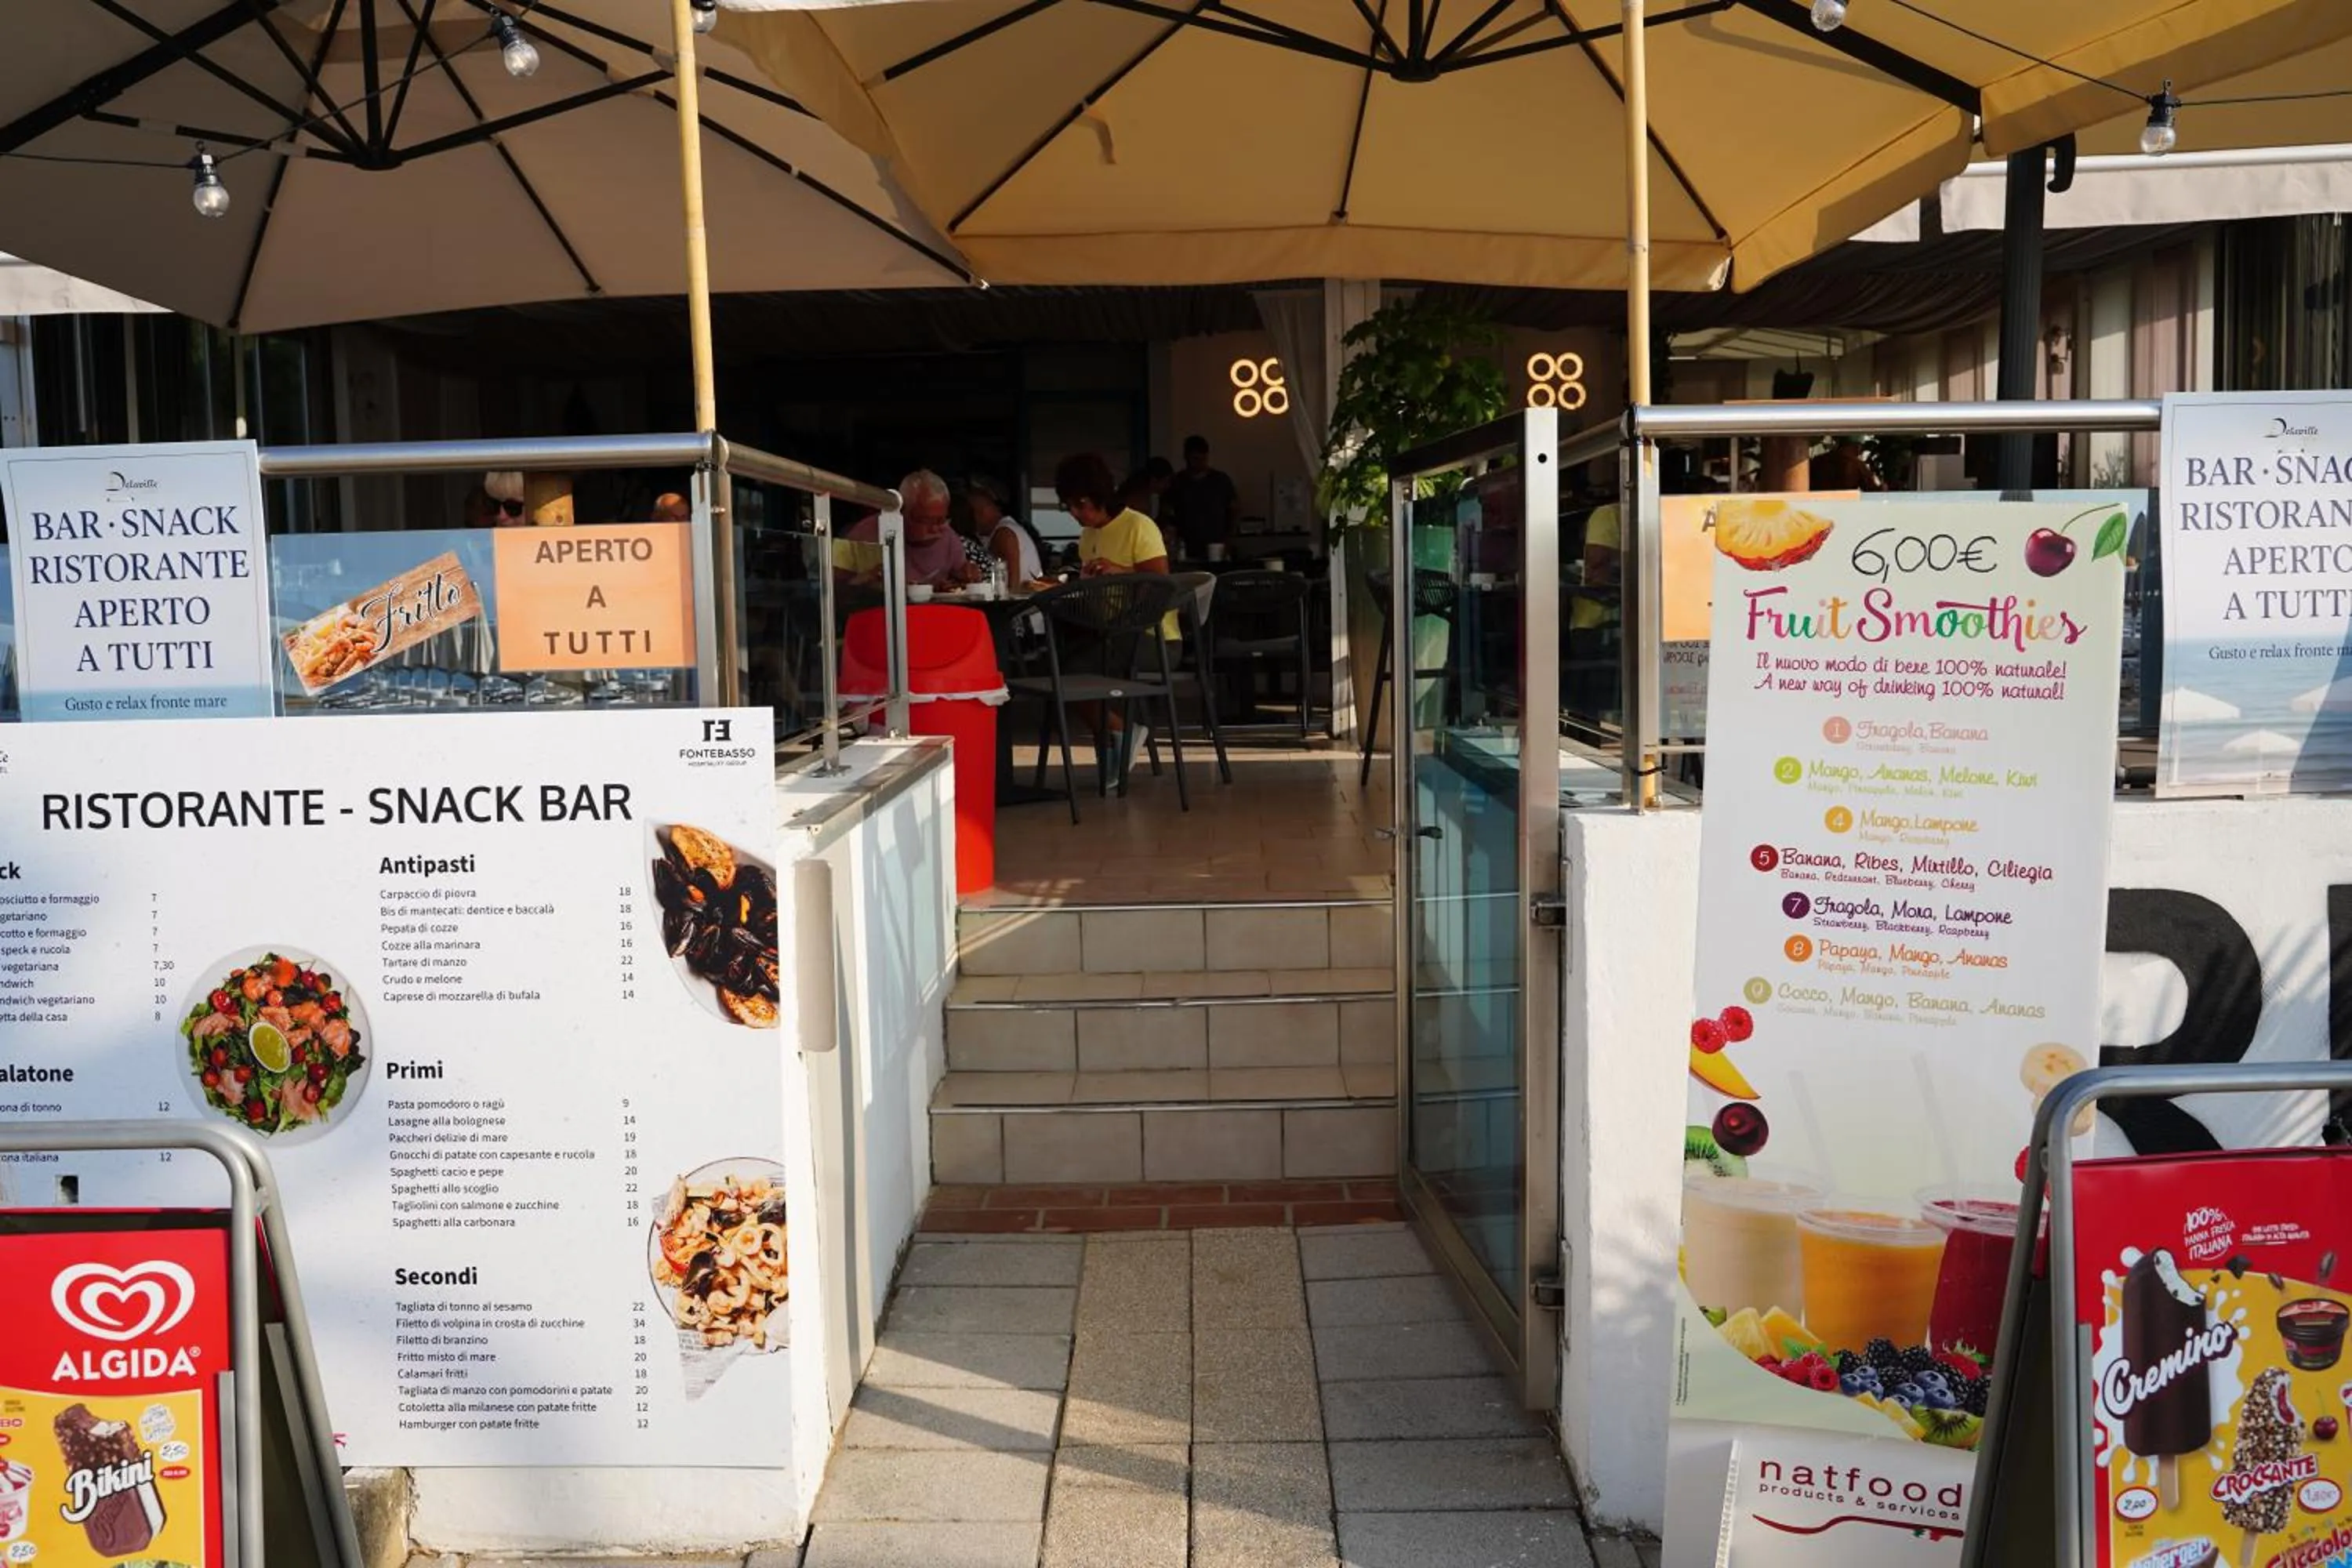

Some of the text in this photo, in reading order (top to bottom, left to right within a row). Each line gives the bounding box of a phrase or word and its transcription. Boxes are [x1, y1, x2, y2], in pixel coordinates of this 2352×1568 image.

[535, 538, 653, 564] APERTO
[1852, 528, 1998, 583] 6,00€
[30, 550, 250, 585] RISTORANTE
[586, 584, 606, 608] A
[2223, 590, 2352, 619] A TUTT
[74, 595, 211, 628] APERTO
[361, 571, 463, 653] Fritto
[1744, 586, 2087, 652] Fruit Smoothies
[544, 629, 652, 655] TUTTI
[2209, 645, 2246, 659] Gusto
[2250, 649, 2257, 659] e
[2260, 644, 2291, 659] relax
[2295, 644, 2332, 658] fronte
[77, 640, 214, 672] A TUTTI
[1756, 652, 2067, 678] Il nuovo modo di bere 100% naturale!
[1754, 673, 2064, 700] A new way of drinking 100% natural!
[65, 693, 227, 712] Gusto e relax fronte mare
[679, 748, 756, 759] FONTEBASSO
[43, 789, 325, 829] RISTORANTE
[368, 785, 524, 825] SNACK
[540, 783, 632, 821] BAR
[379, 855, 474, 877] Antipasti
[1781, 848, 1845, 869] Banana,
[1855, 853, 1903, 871] Ribes,
[1988, 860, 2052, 884] Ciliegia
[380, 887, 630, 900] Carpaccio di piovra 18
[1814, 897, 1883, 918] Fragola,
[1945, 905, 2013, 927] Lampone
[1, 946, 28, 956] speck
[40, 945, 70, 954] rucola
[383, 958, 418, 967] Tartare
[420, 958, 430, 967] di
[621, 955, 633, 964] 22
[1947, 949, 2008, 968] Ananas
[2, 963, 59, 974] vegetariana
[383, 992, 423, 1003] Caprese
[439, 991, 494, 1000] mozzarella
[496, 991, 505, 1000] di
[509, 991, 539, 1000] bufala
[623, 990, 633, 999] 14
[387, 1061, 442, 1079] Primi
[389, 1117, 430, 1127] Lasagne
[433, 1116, 450, 1126] alla
[453, 1116, 505, 1127] bolognese
[390, 1150, 430, 1160] Gnocchi
[445, 1151, 477, 1160] patate
[500, 1151, 552, 1160] capesante
[563, 1149, 594, 1159] rucola
[392, 1184, 439, 1196] Spaghetti
[442, 1184, 460, 1193] allo
[463, 1184, 499, 1195] scoglio
[395, 1267, 477, 1285] Secondi
[397, 1336, 646, 1345] Filetto di branzino 18
[397, 1369, 647, 1378] Calamari fritti 18
[2103, 1323, 2236, 1418] Cremino
[400, 1420, 456, 1431] Hamburger
[480, 1421, 512, 1429] patate
[514, 1419, 539, 1428] fritte
[638, 1419, 648, 1428] 12
[60, 1450, 154, 1523] Bikini
[1760, 1461, 1962, 1508] natfood
[2211, 1455, 2317, 1501] CROCCANTE
[1759, 1483, 1960, 1521] products & services
